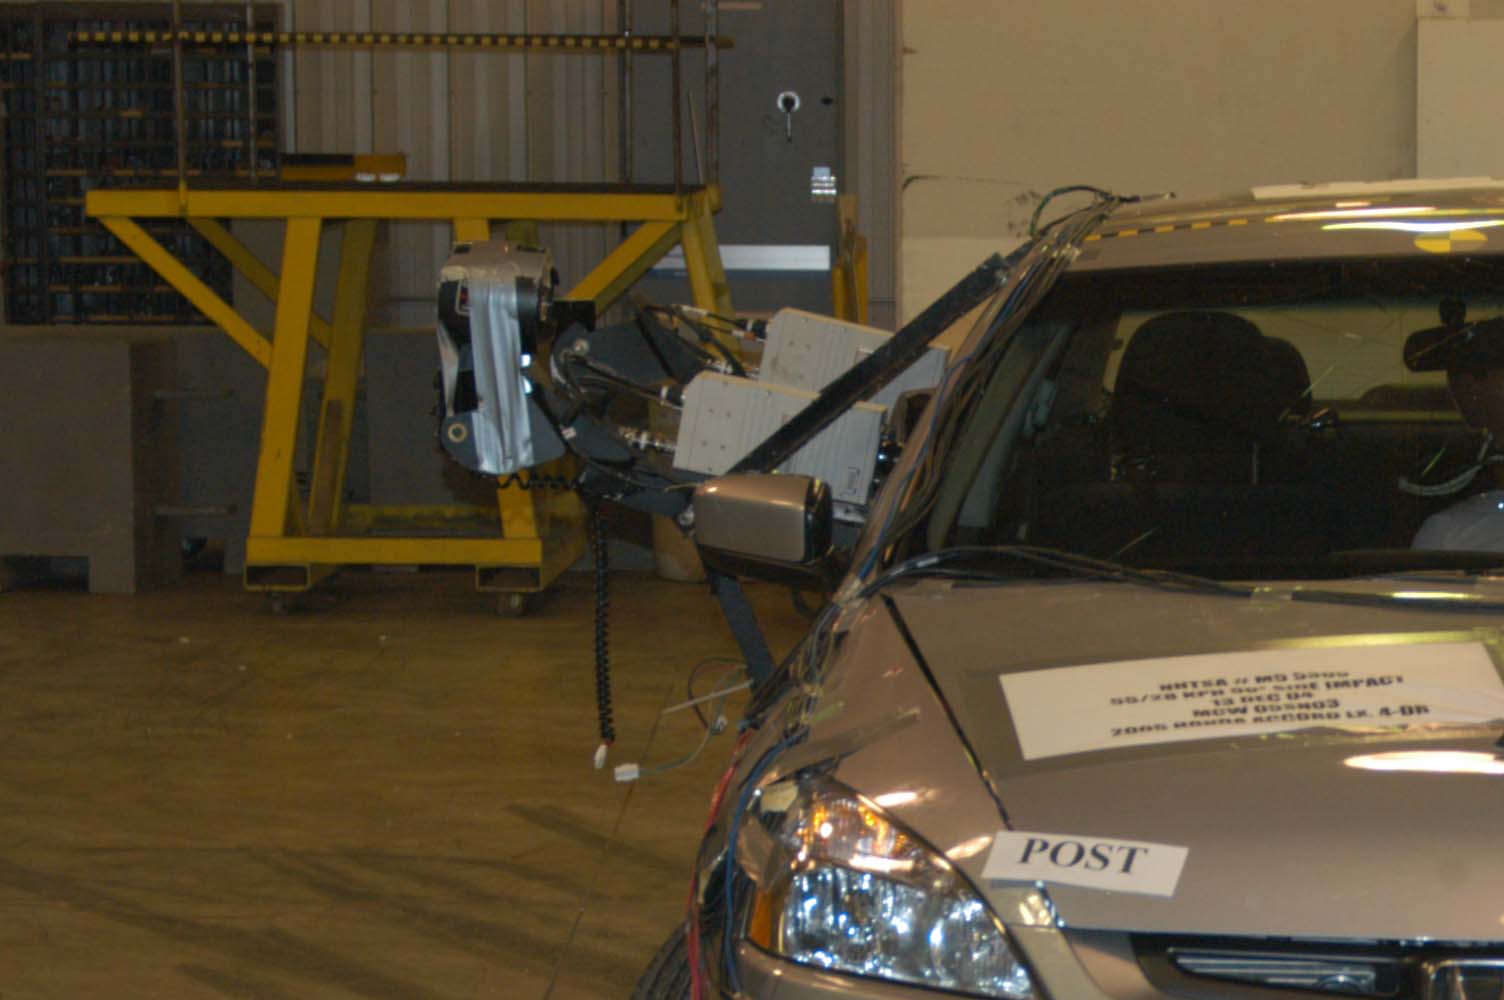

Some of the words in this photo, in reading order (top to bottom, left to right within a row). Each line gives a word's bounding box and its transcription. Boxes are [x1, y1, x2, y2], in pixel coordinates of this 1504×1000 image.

[1325, 675, 1404, 689] IMPACT
[1240, 693, 1280, 703] DEC
[1110, 723, 1167, 737] 2005
[1173, 717, 1246, 729] HONDA
[1253, 712, 1340, 723] ACCORD
[1379, 704, 1430, 717] 4-DR
[1019, 837, 1148, 875] POST
